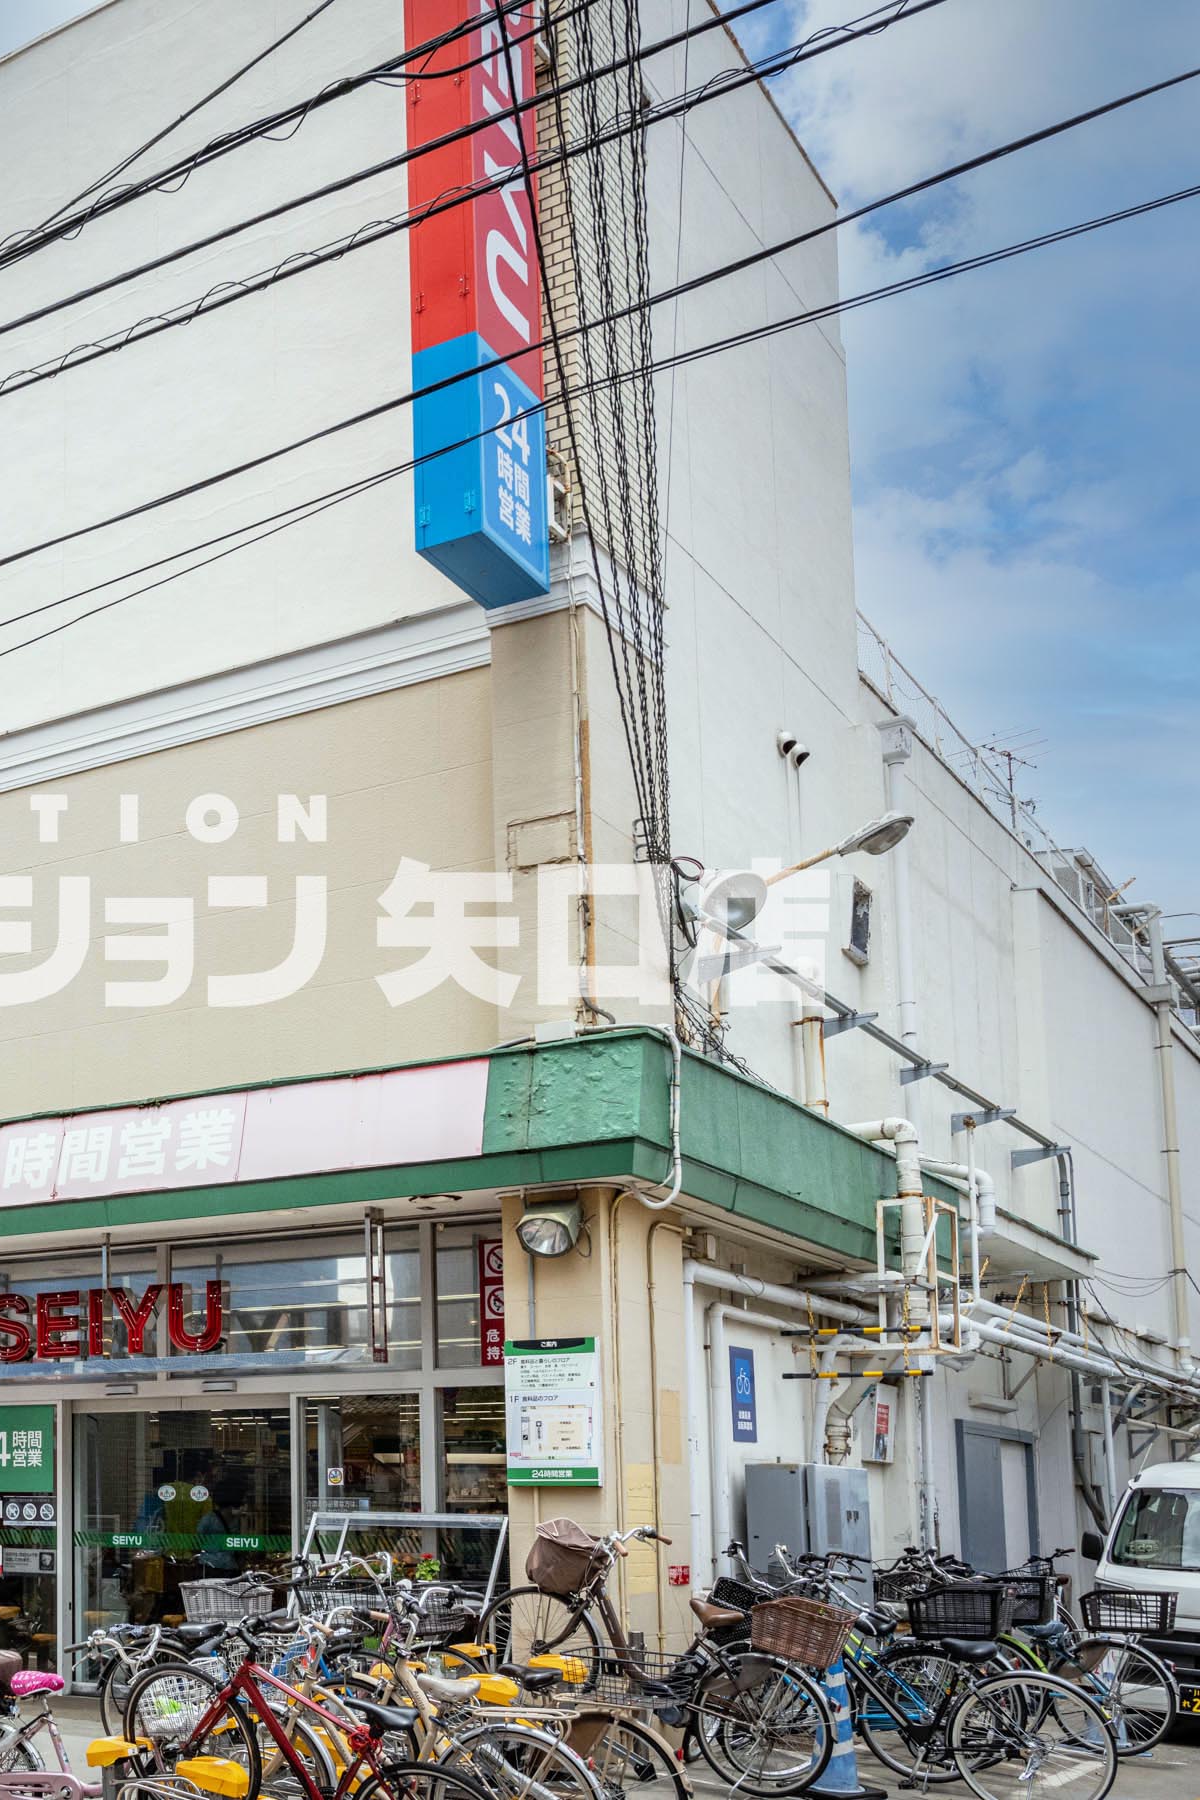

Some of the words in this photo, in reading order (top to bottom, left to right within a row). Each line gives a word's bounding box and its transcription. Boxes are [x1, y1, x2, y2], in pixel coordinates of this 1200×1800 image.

[480, 0, 530, 346] EIYU
[507, 1358, 518, 1366] 2F
[510, 1395, 520, 1403] 1F
[12, 1430, 42, 1449] 時間
[12, 1448, 42, 1468] 営業
[531, 1469, 574, 1479] 24時間営業
[112, 1535, 143, 1546] SEIYU
[226, 1537, 259, 1548] SEIYU
